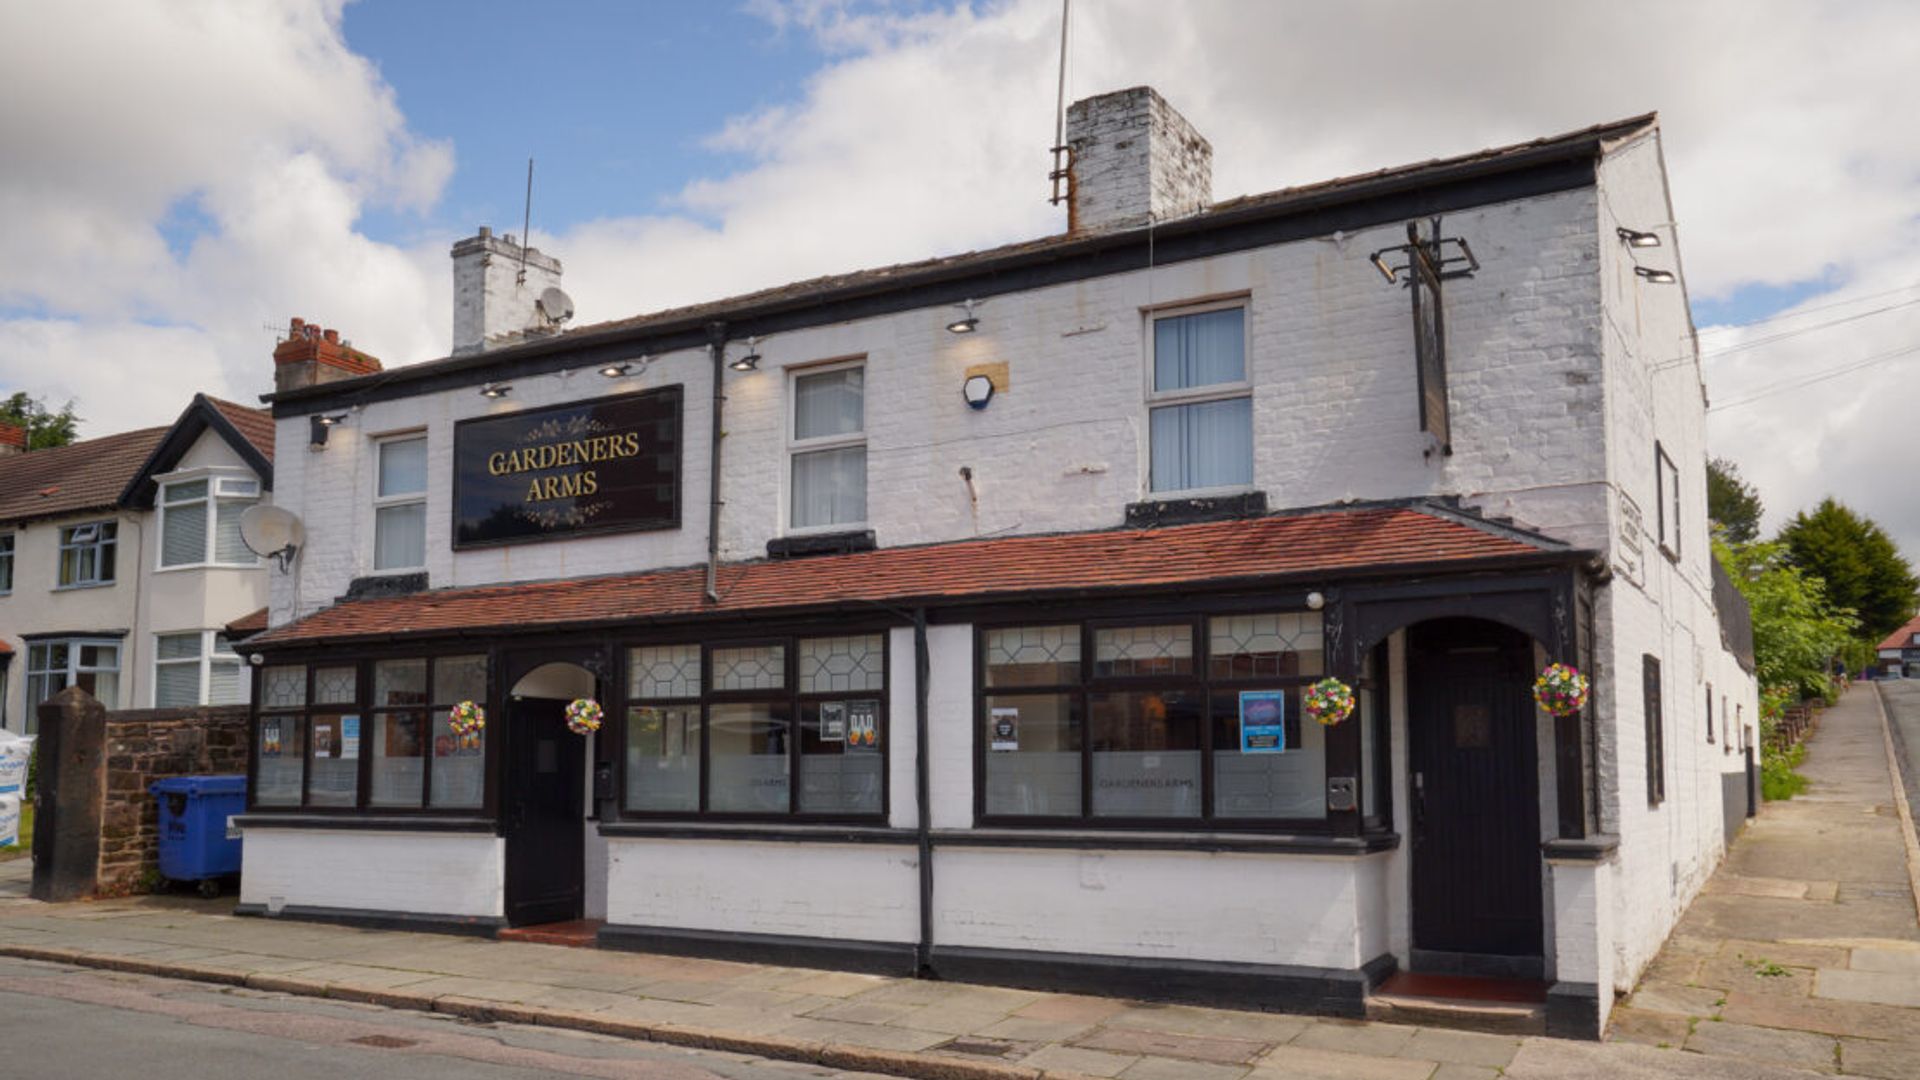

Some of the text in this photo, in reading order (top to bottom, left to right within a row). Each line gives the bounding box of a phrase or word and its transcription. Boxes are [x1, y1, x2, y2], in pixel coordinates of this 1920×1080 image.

[488, 432, 639, 476] GARDENERS
[527, 471, 598, 502] ARMS
[1099, 778, 1194, 789] GARDENERS ARMS
